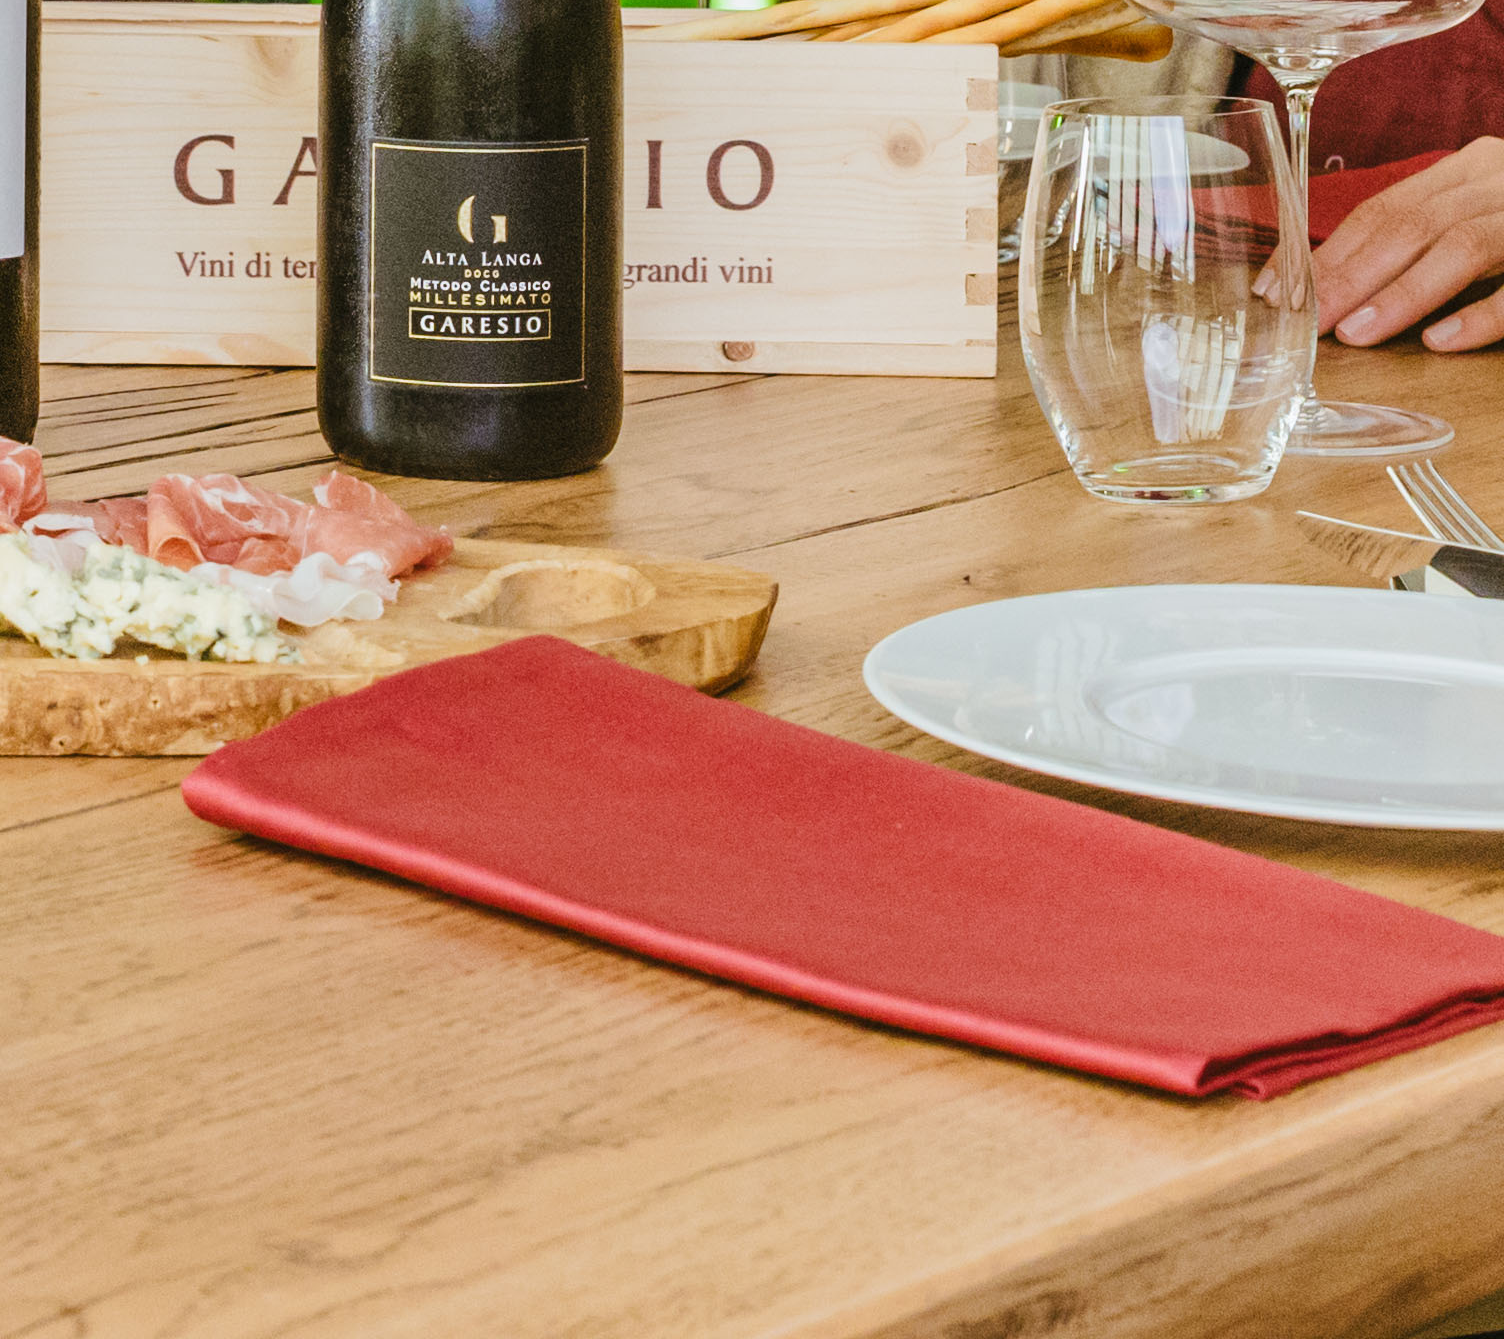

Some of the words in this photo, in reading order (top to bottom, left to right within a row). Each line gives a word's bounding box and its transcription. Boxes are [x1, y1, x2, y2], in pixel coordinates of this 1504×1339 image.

[457, 195, 508, 244] G
[422, 249, 468, 266] ALTA
[481, 251, 542, 267] LANGA
[176, 251, 235, 278] Vini
[245, 252, 272, 278] di
[719, 257, 773, 284] vini
[464, 269, 500, 278] DOCG
[410, 277, 472, 291] METODO
[479, 280, 551, 292] CLASSICO
[409, 291, 551, 306] MILLESIMATO
[420, 314, 542, 334] GARESIO
